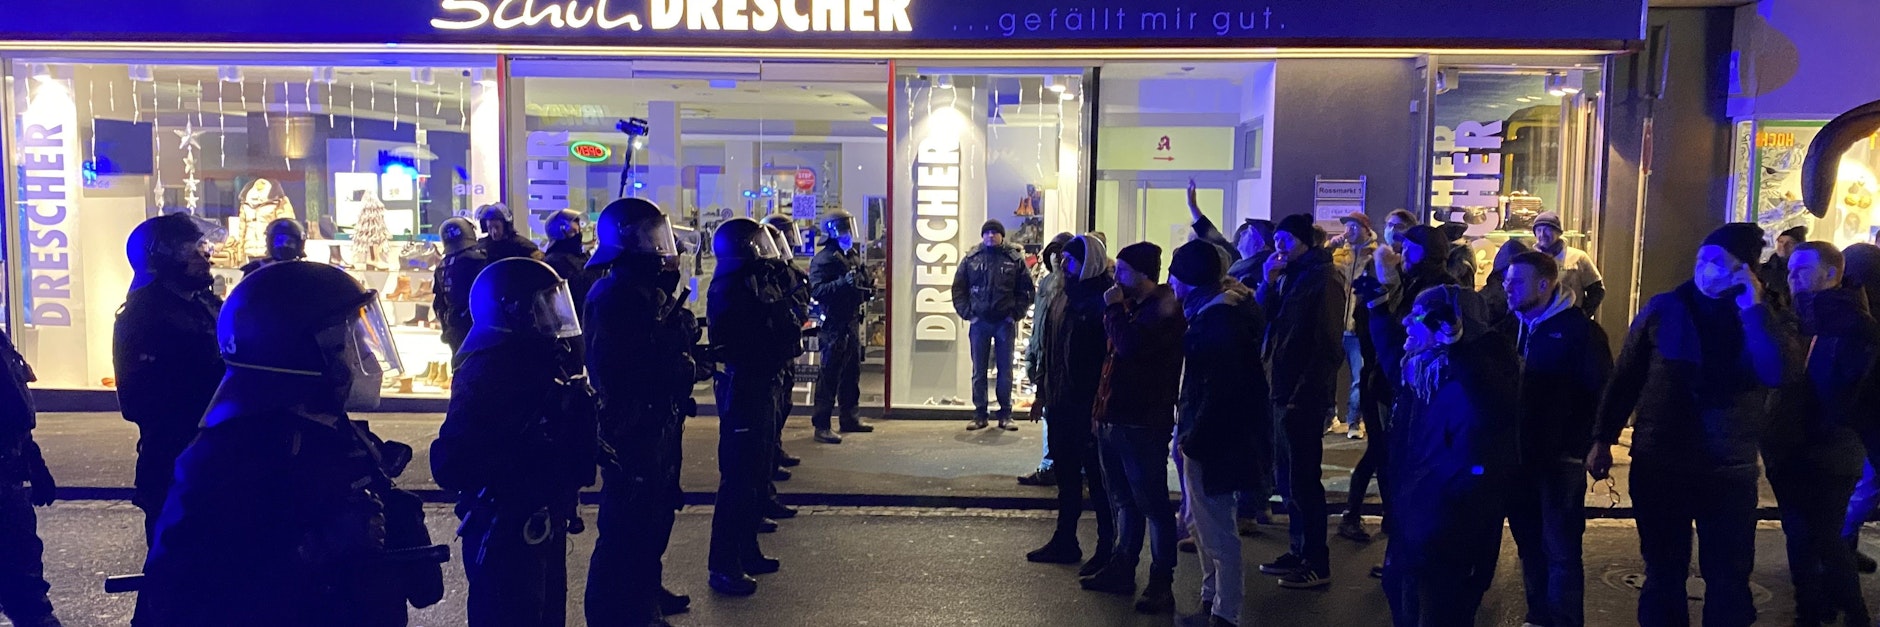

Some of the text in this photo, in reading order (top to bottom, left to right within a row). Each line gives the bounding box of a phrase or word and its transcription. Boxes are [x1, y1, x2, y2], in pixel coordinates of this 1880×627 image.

[650, 0, 913, 32] DRESCHER
[1141, 8, 1197, 30] mir
[1213, 7, 1285, 36] gut.
[454, 183, 485, 195] ara
[24, 123, 72, 327] DRESCHER
[915, 134, 960, 341] DRESCHER
